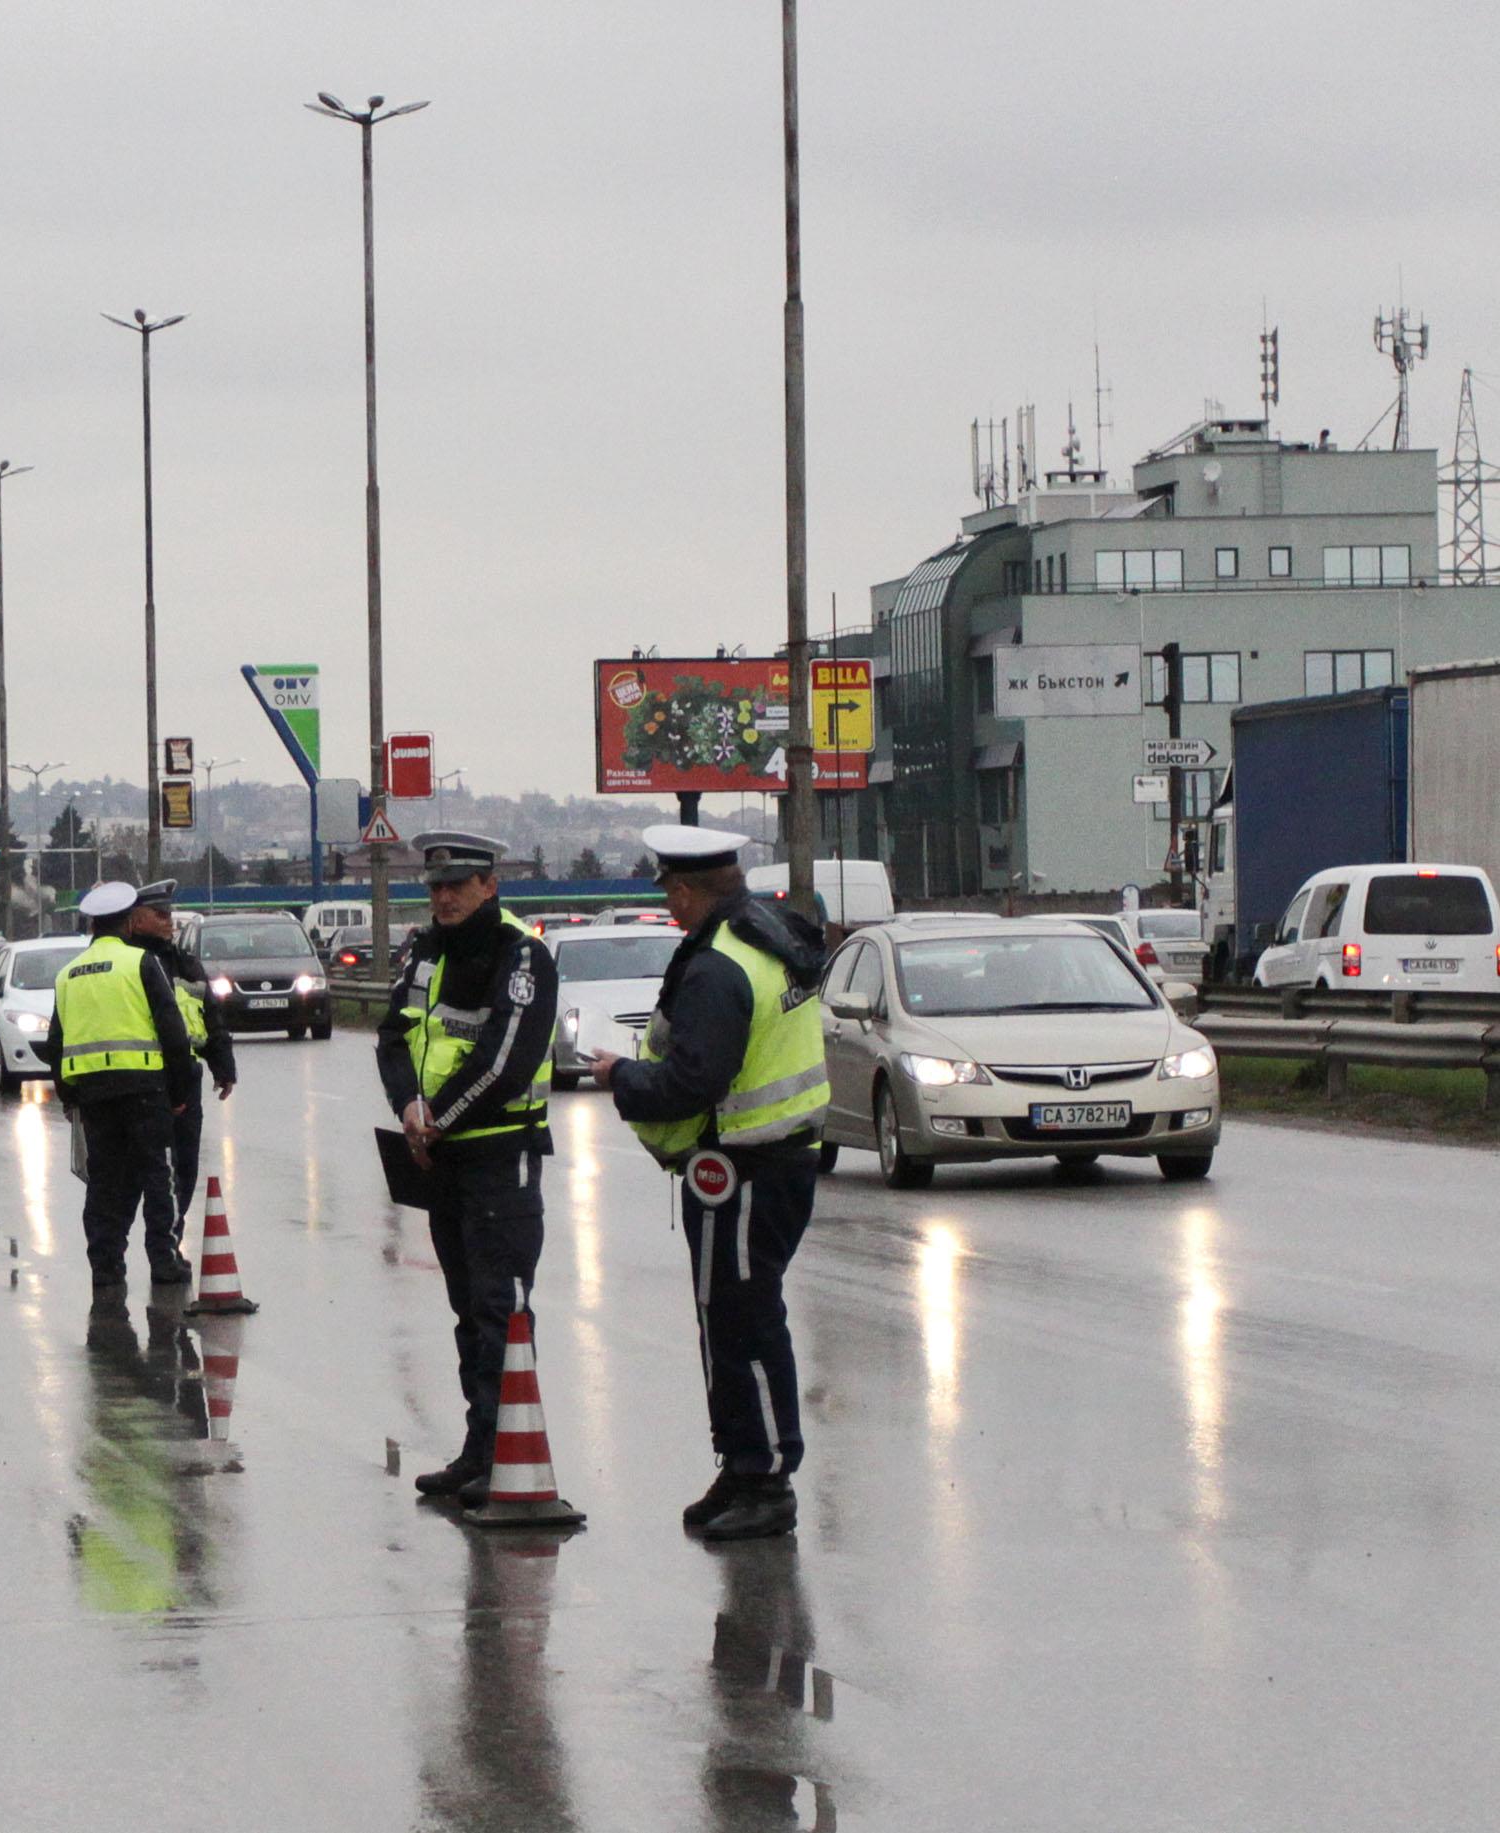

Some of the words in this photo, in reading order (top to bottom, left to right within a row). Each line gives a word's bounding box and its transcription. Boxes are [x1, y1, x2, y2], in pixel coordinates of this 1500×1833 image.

[816, 666, 869, 684] BILLA
[1008, 677, 1029, 691] жк
[1037, 674, 1105, 691] Бъкстон
[274, 694, 312, 706] OMV
[392, 746, 430, 759] JUMBO
[1147, 740, 1199, 750] магазин
[1147, 751, 1200, 765] dekora
[69, 961, 112, 979] POLICE
[434, 1096, 470, 1130] TRAFFIC
[464, 1070, 498, 1102] POLICE
[1043, 1108, 1063, 1123] CA
[1067, 1107, 1104, 1123] 3782
[1107, 1107, 1127, 1122] HA
[697, 1168, 725, 1184] МВР
